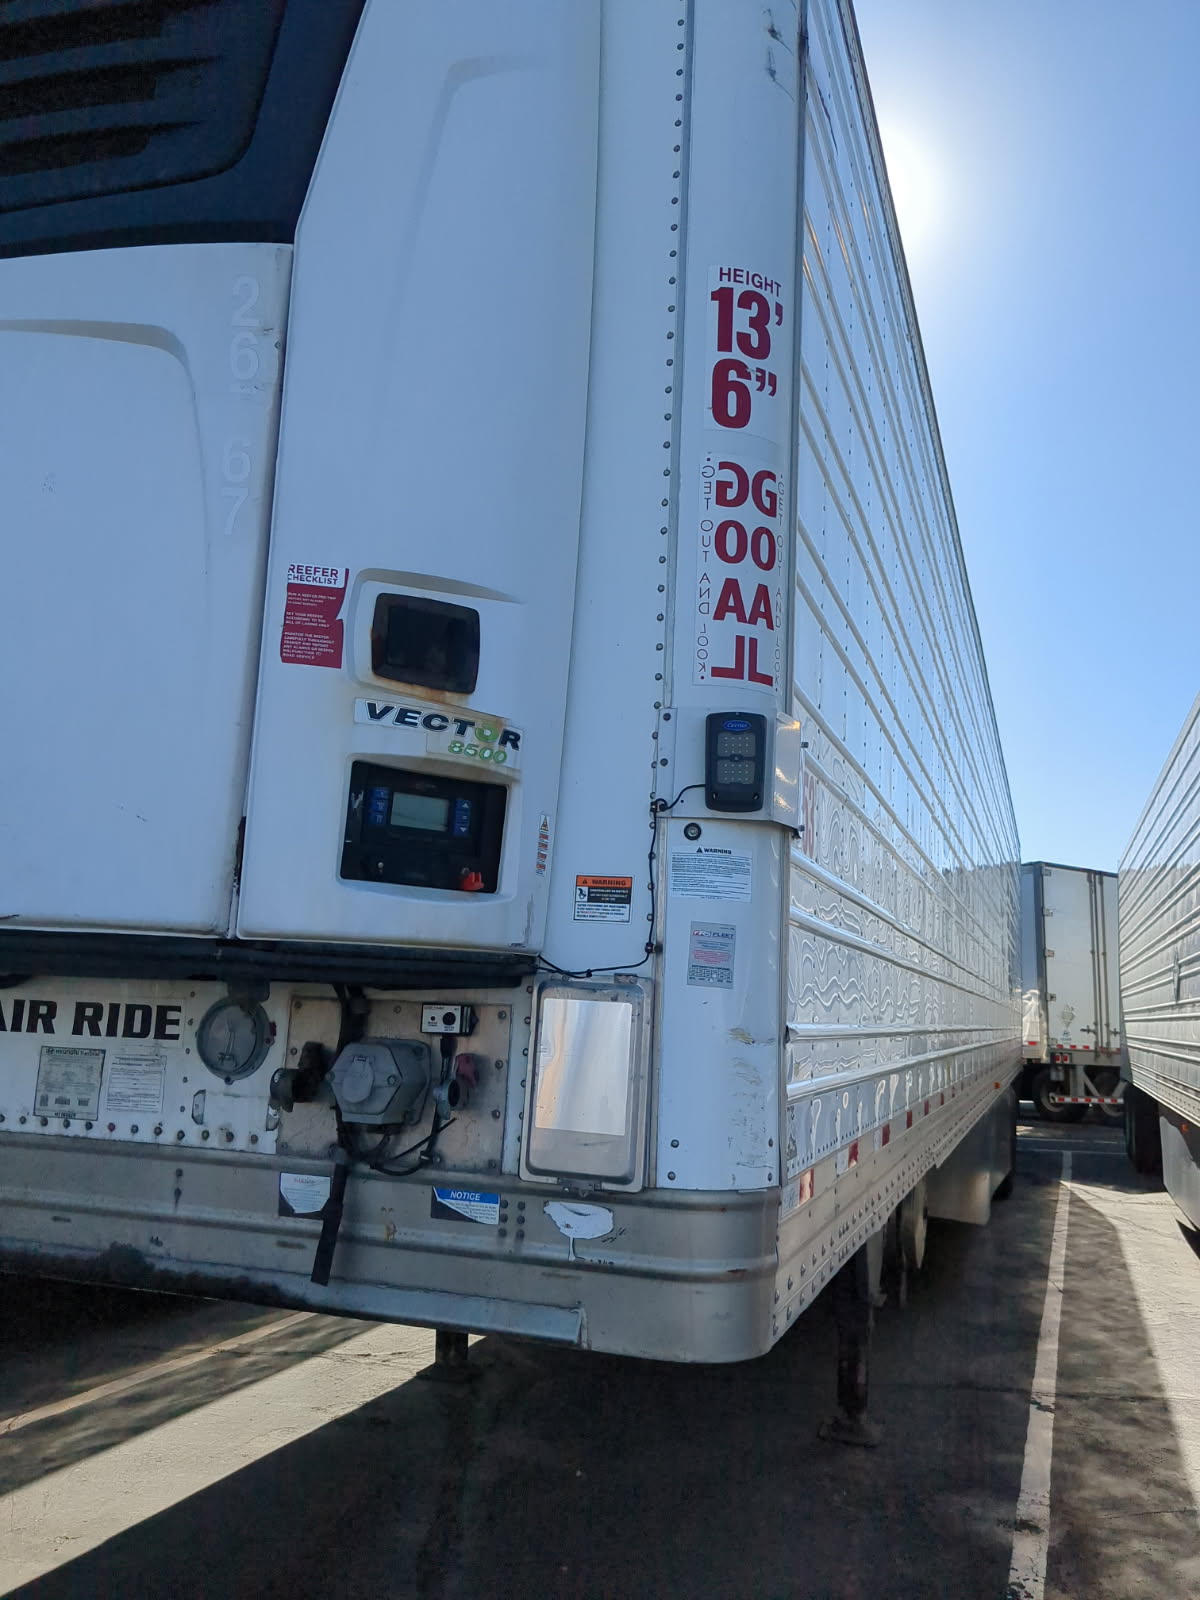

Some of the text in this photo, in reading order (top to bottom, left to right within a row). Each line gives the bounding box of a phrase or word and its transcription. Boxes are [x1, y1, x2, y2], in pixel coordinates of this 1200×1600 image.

[719, 267, 782, 297] HEIGHT
[711, 286, 783, 360] 13'
[288, 564, 338, 578] REEFER
[288, 573, 338, 585] CHECKLIST
[366, 701, 521, 751] VECTOR
[448, 740, 508, 764] 8500
[703, 847, 732, 855] WARNING
[0, 999, 182, 1040] IR RIDE
[450, 1190, 481, 1201] NOTICE
